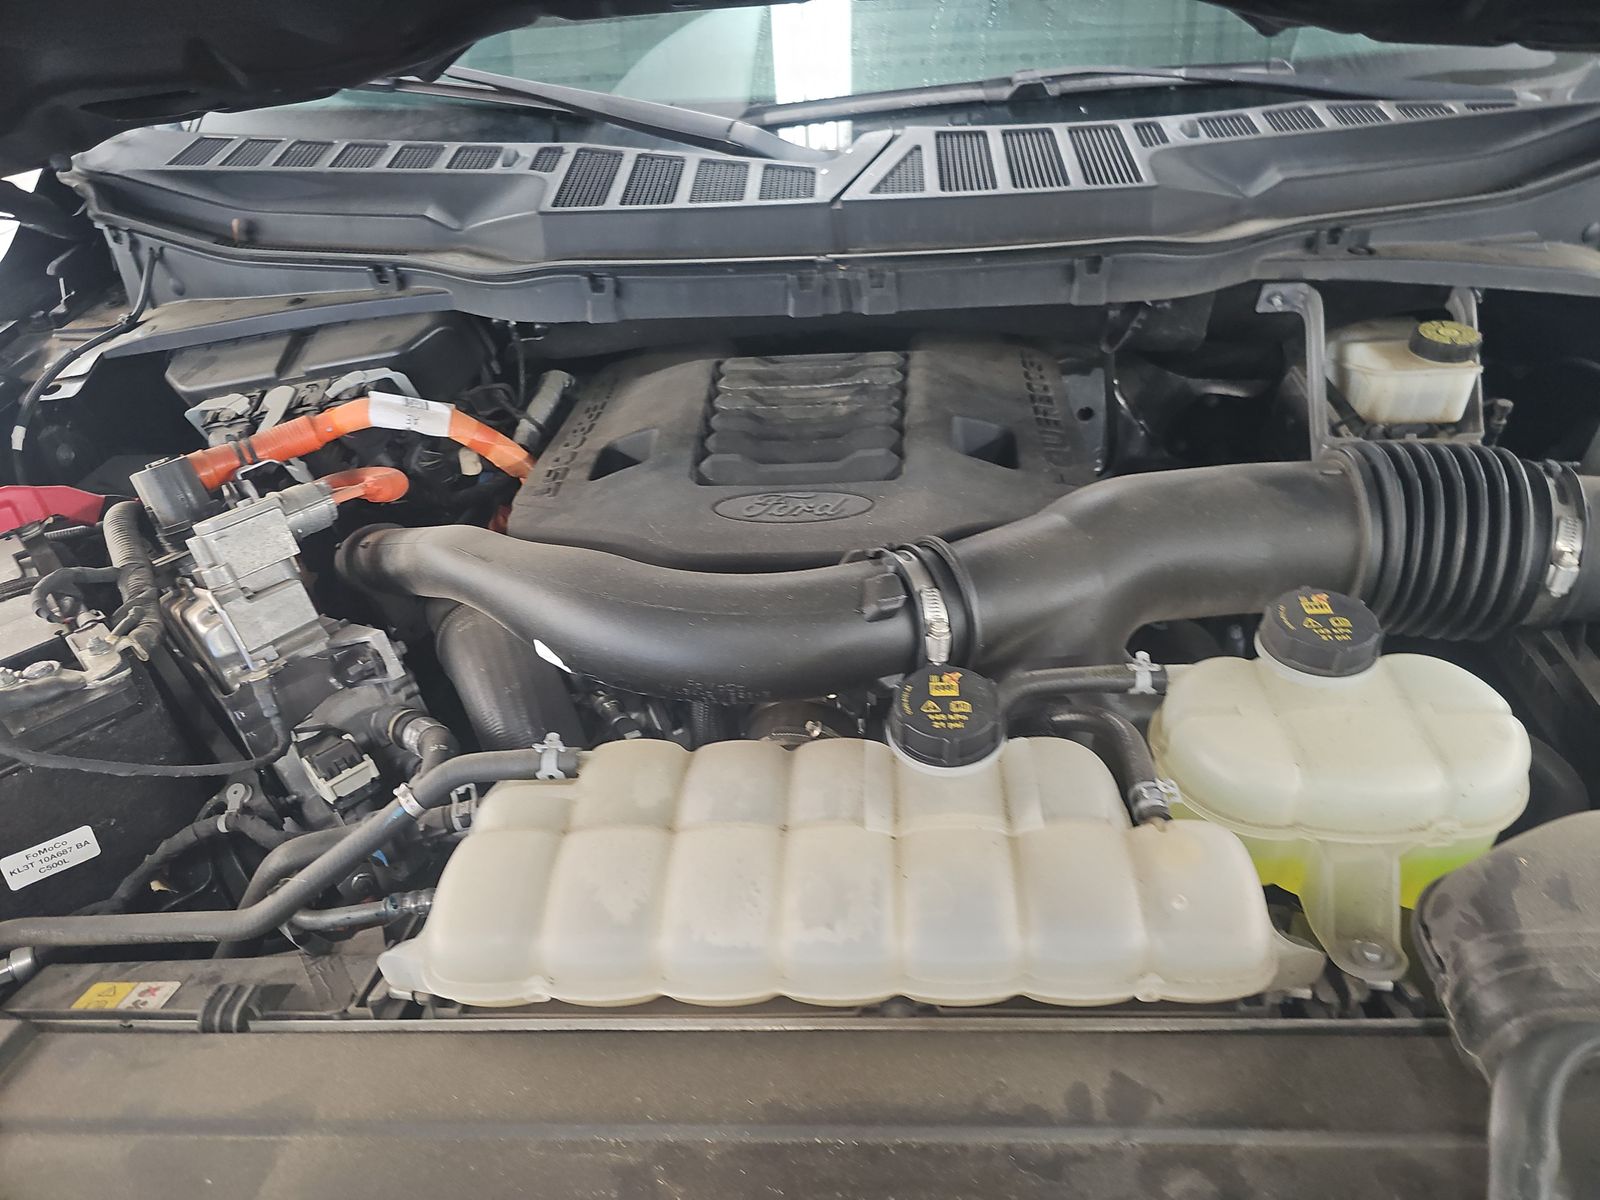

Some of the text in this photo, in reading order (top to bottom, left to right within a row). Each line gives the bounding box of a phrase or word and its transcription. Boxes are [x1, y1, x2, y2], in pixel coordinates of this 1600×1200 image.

[743, 492, 848, 518] Ford
[9, 839, 91, 877] KL3T 10A687 BA
[25, 840, 68, 861] FoMoCo
[38, 858, 70, 874] C500L
